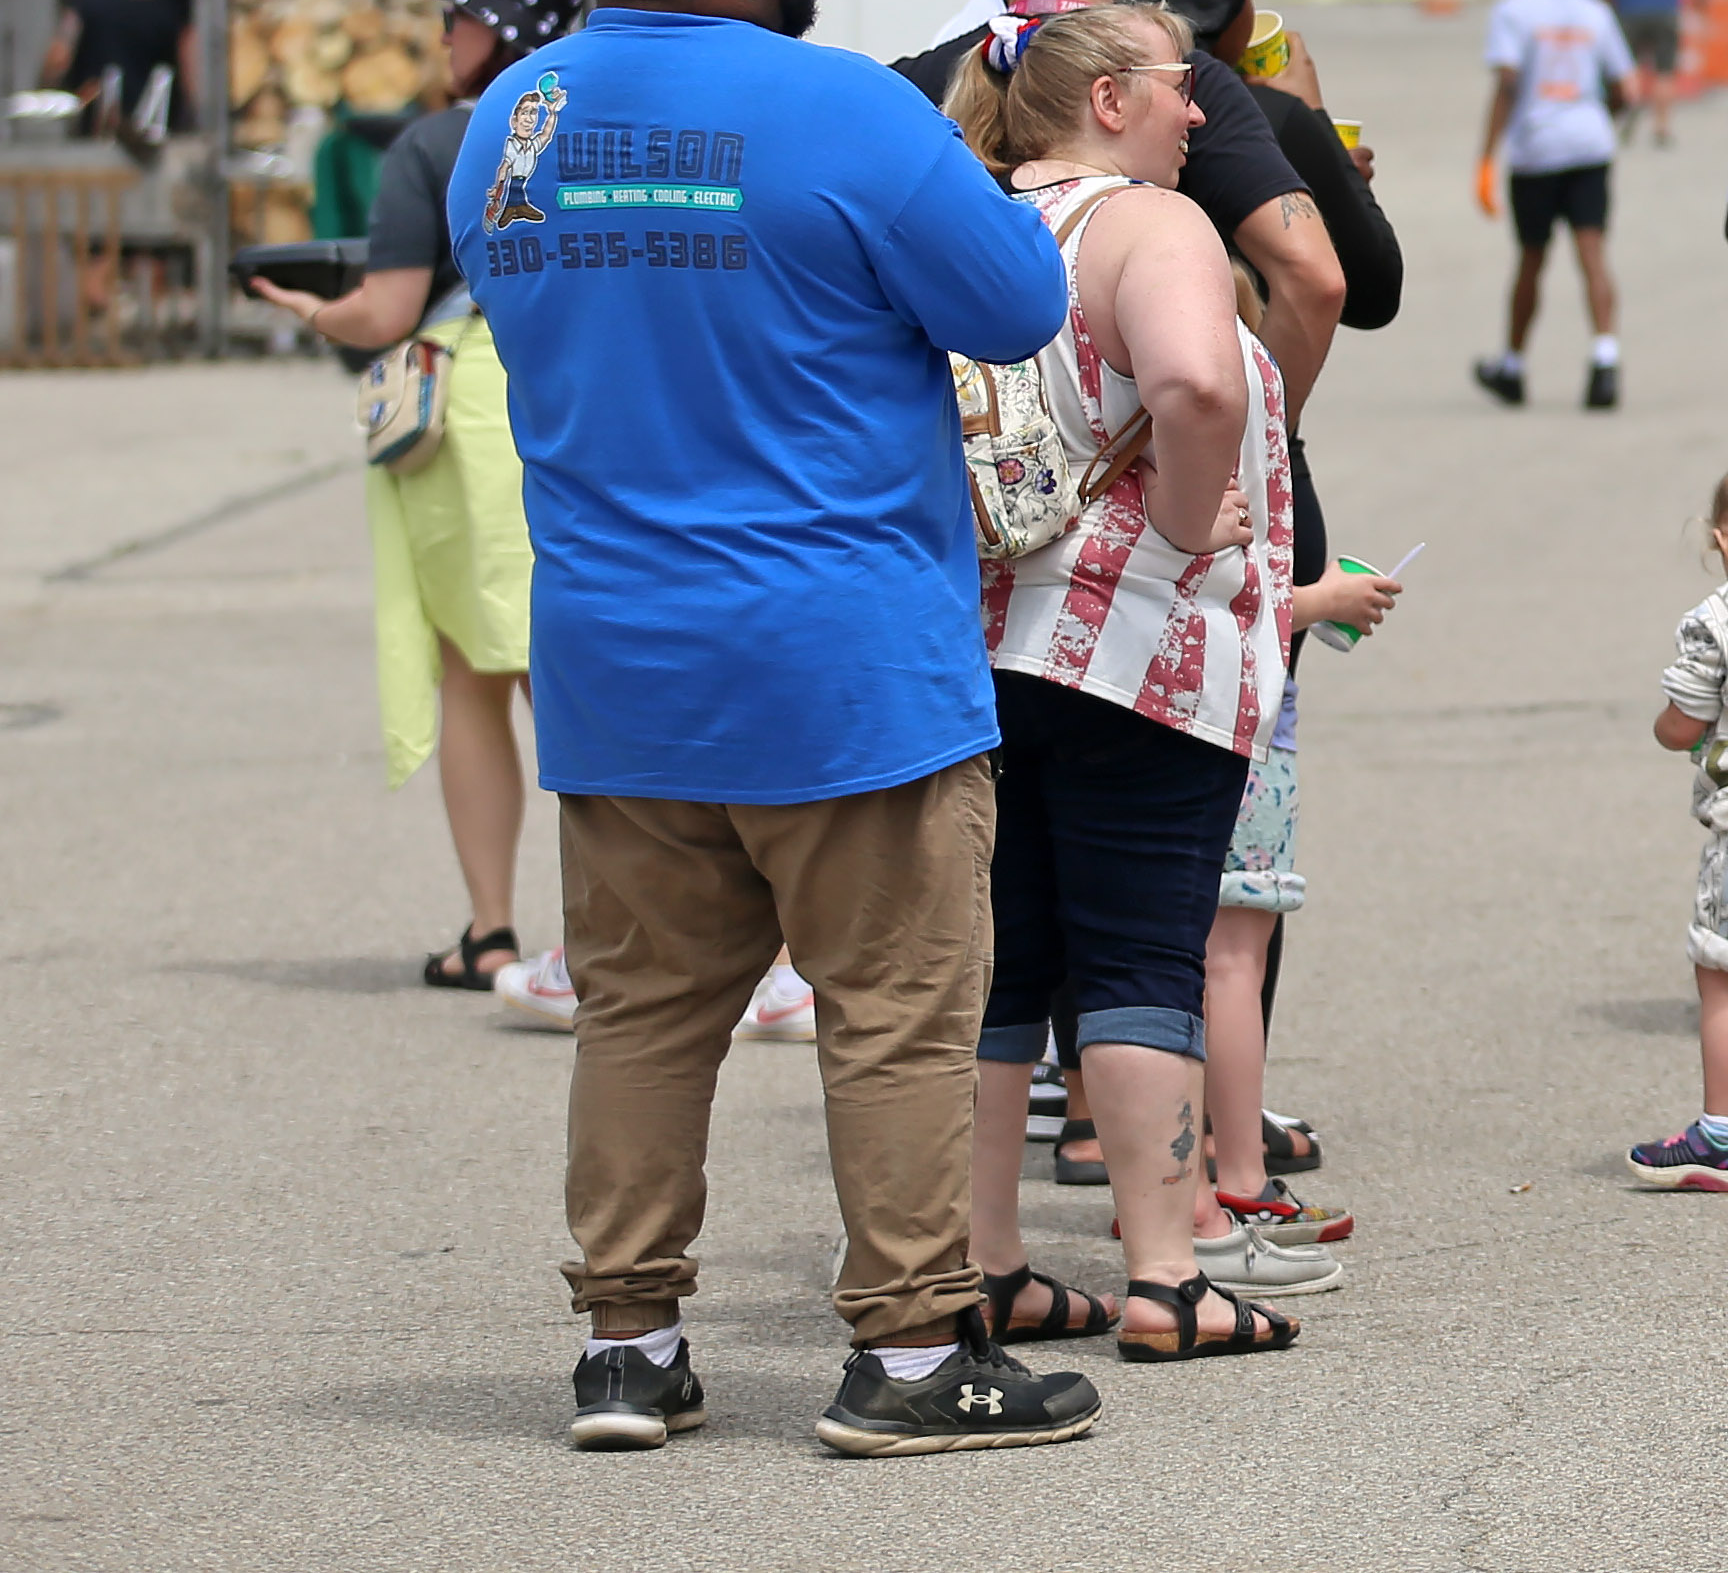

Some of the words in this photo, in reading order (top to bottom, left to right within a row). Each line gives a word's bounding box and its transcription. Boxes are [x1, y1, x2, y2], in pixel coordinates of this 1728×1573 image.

[557, 129, 745, 183] WILSON
[563, 191, 607, 206] PLUMBING
[613, 189, 648, 203] HEATING
[653, 189, 687, 204] COOLING
[693, 191, 737, 207] ELECTRIC
[487, 231, 748, 277] 330-535-5386
